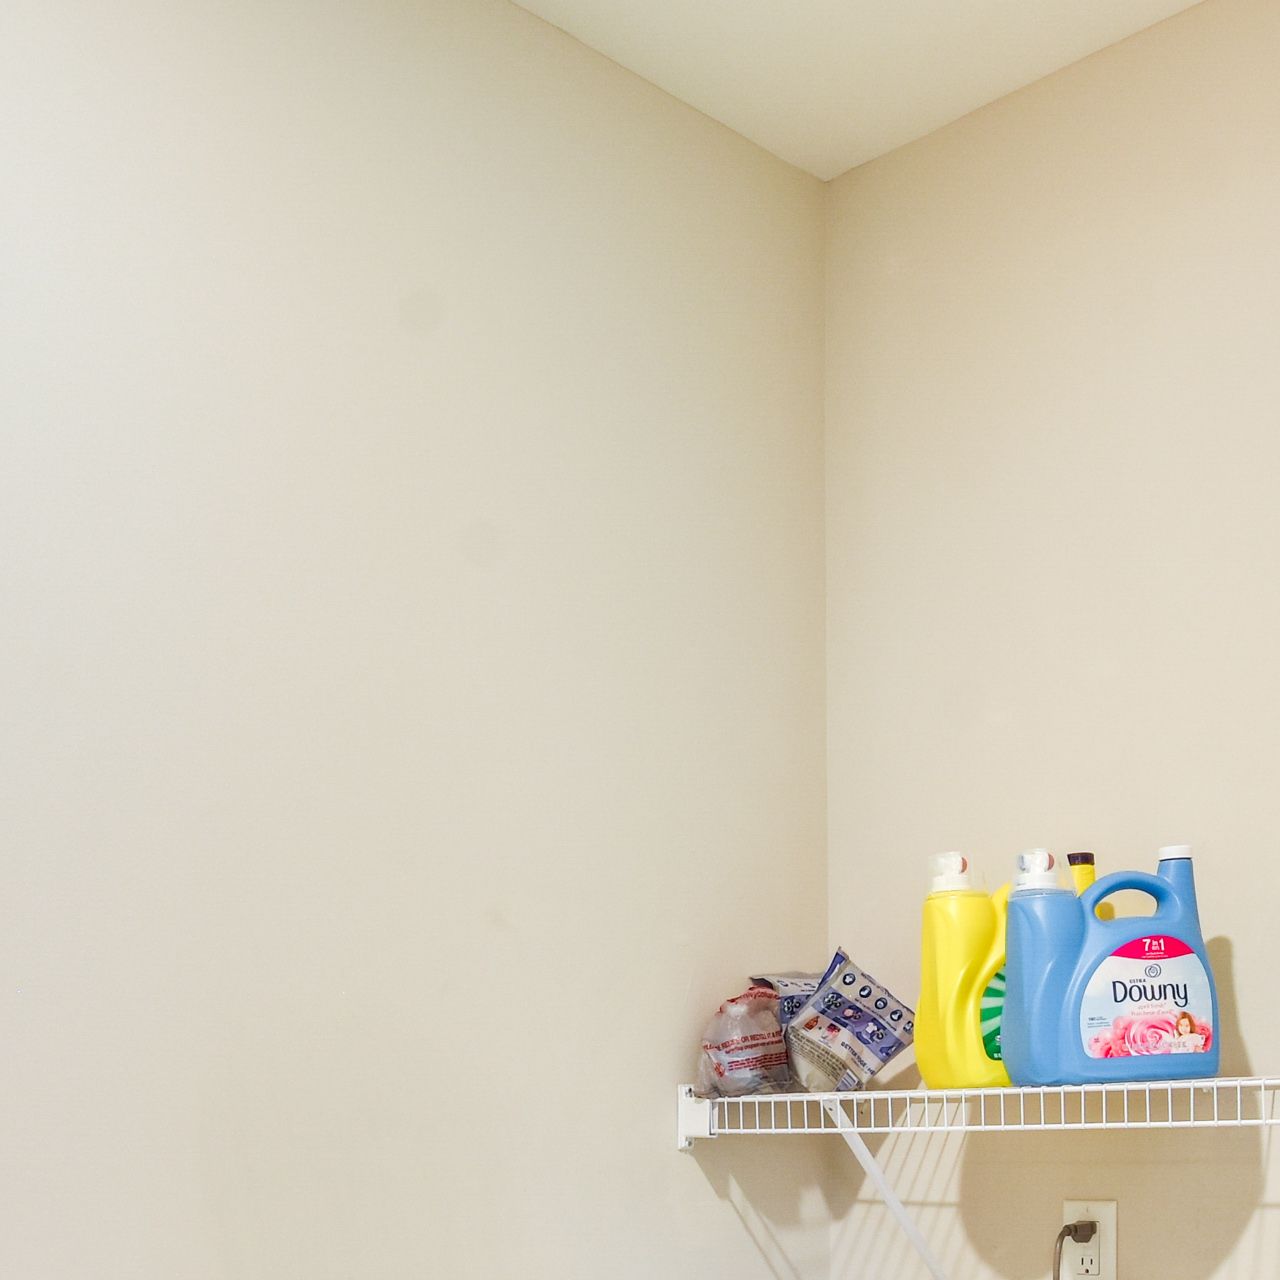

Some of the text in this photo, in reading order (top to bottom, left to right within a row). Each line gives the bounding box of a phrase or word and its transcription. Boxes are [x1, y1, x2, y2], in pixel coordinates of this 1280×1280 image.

[1142, 939, 1151, 951] 7
[1159, 938, 1165, 951] 1
[1112, 980, 1189, 1008] Downy
